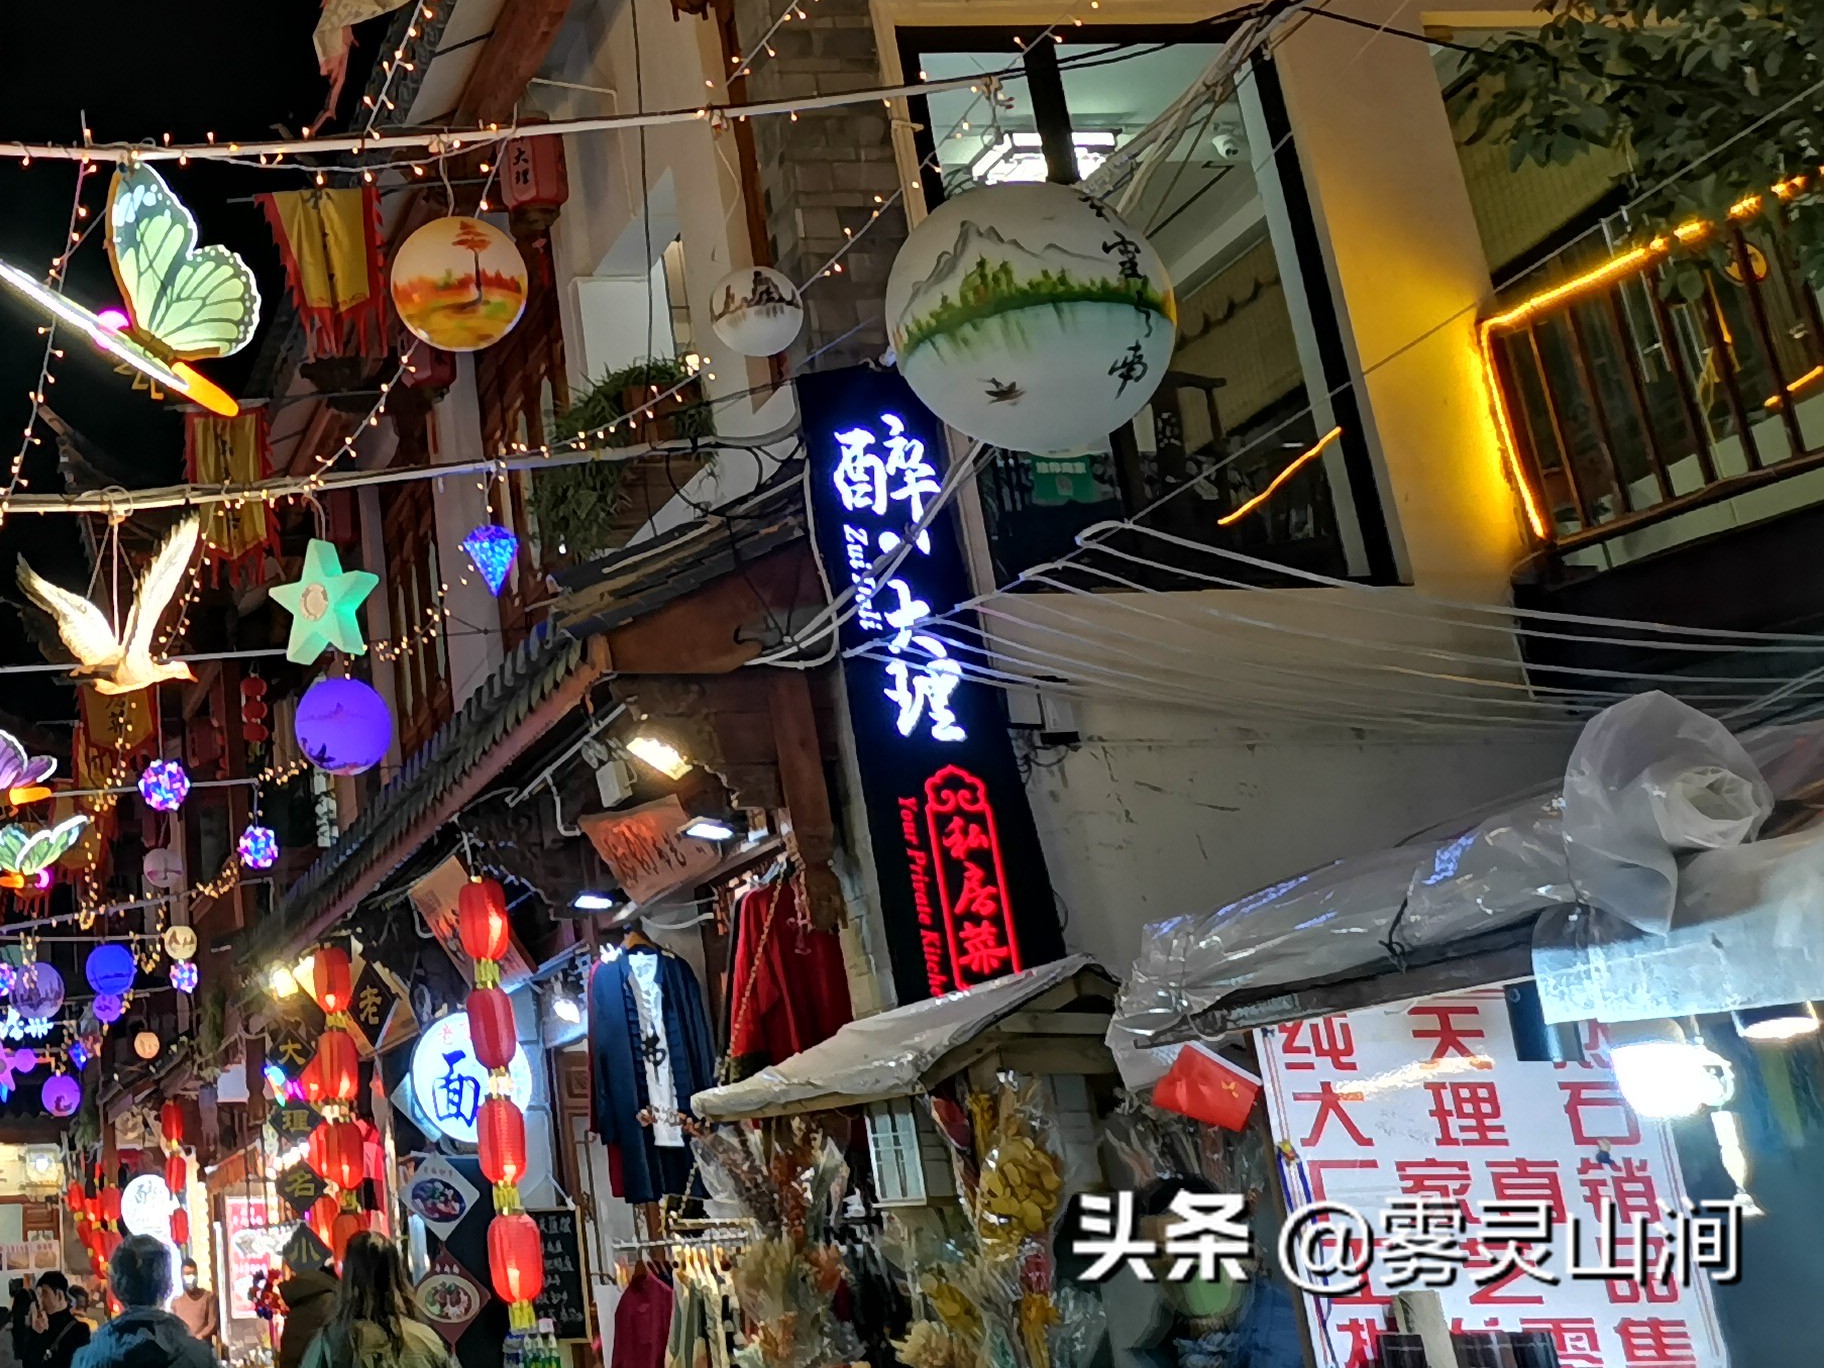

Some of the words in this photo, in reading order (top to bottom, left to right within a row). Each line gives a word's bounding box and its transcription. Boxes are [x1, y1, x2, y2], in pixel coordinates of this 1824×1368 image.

[898, 797, 919, 846] Your
[907, 848, 933, 926] Private
[943, 816, 1011, 975] 私房菜
[921, 929, 949, 999] Kitche
